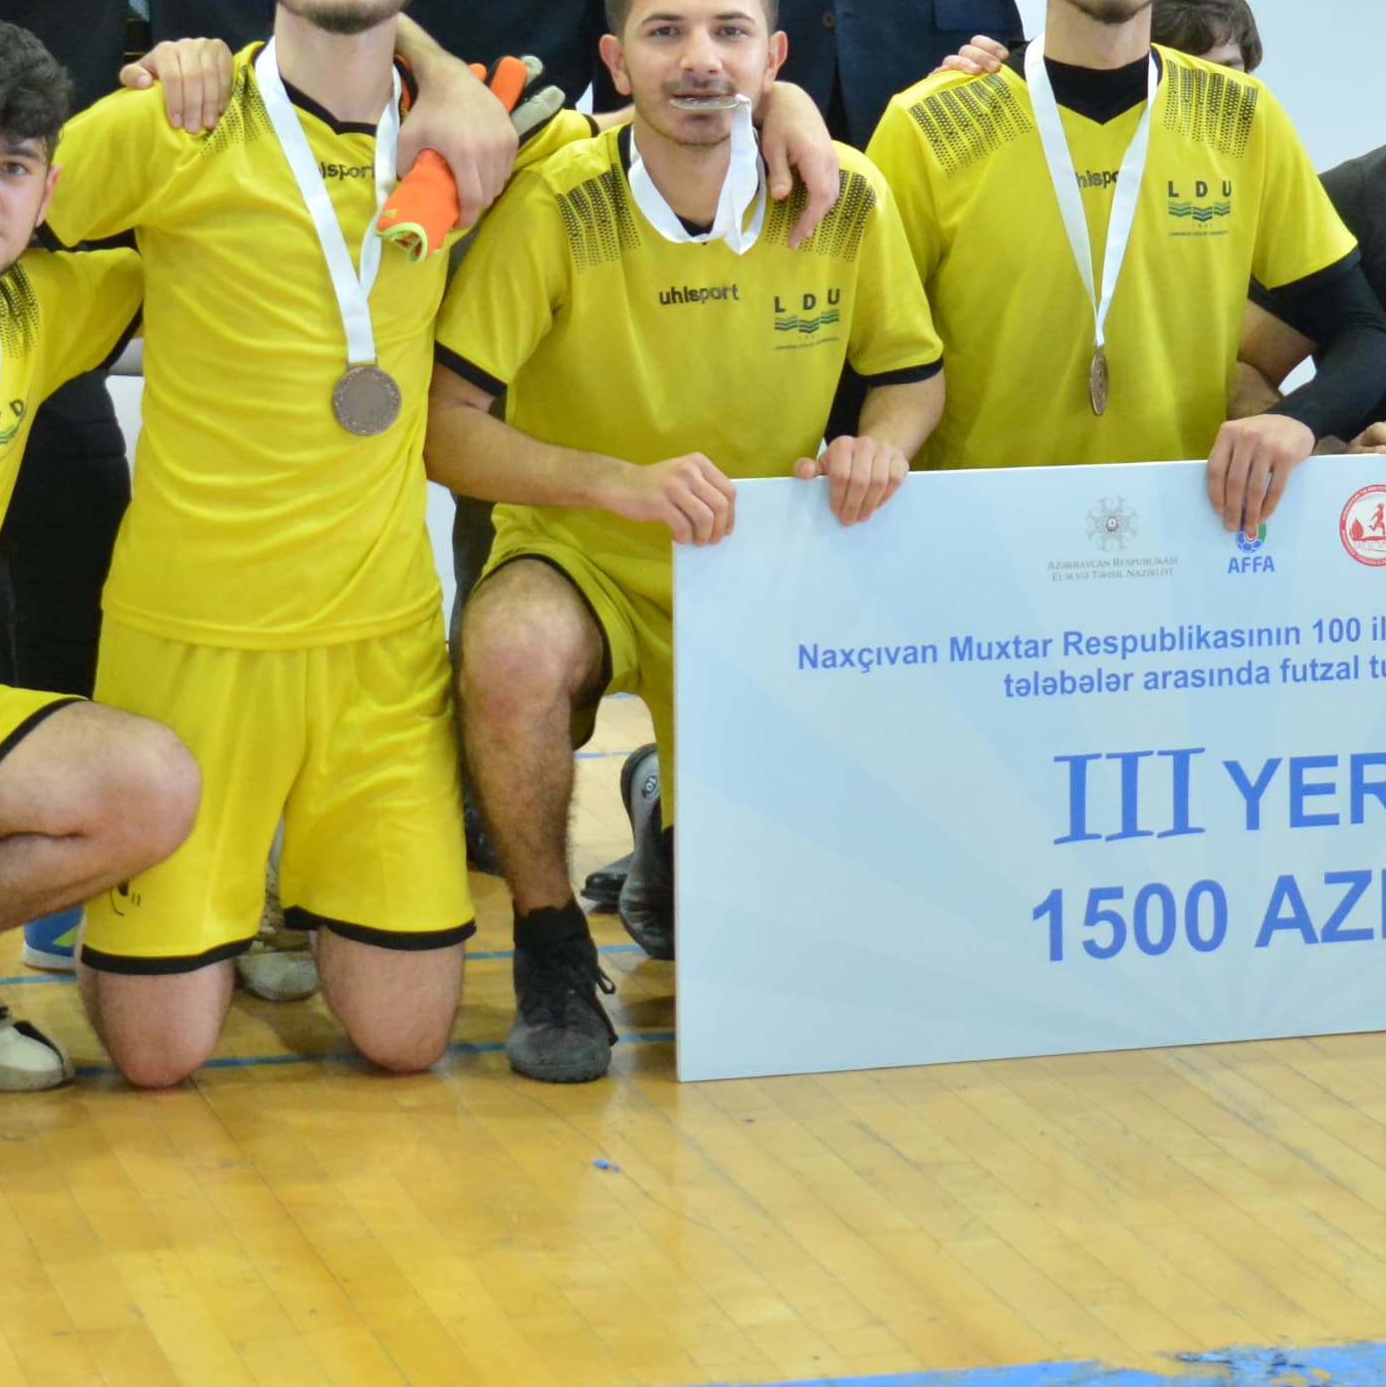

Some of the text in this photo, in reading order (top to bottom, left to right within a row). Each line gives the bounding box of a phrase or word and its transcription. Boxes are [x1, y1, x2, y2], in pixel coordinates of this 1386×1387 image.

[659, 283, 740, 306] uhlsport
[1227, 555, 1275, 574] AFFA
[798, 643, 938, 674] Naxçıvan
[949, 635, 1054, 663] Muxtar
[1063, 622, 1301, 659] Respublikasının
[1312, 617, 1361, 644] 100
[1003, 667, 1134, 698] tələbələr
[1143, 660, 1270, 691] arasında
[1279, 654, 1359, 683] futzal
[1052, 747, 1206, 846] III
[1032, 879, 1228, 962] 1500
